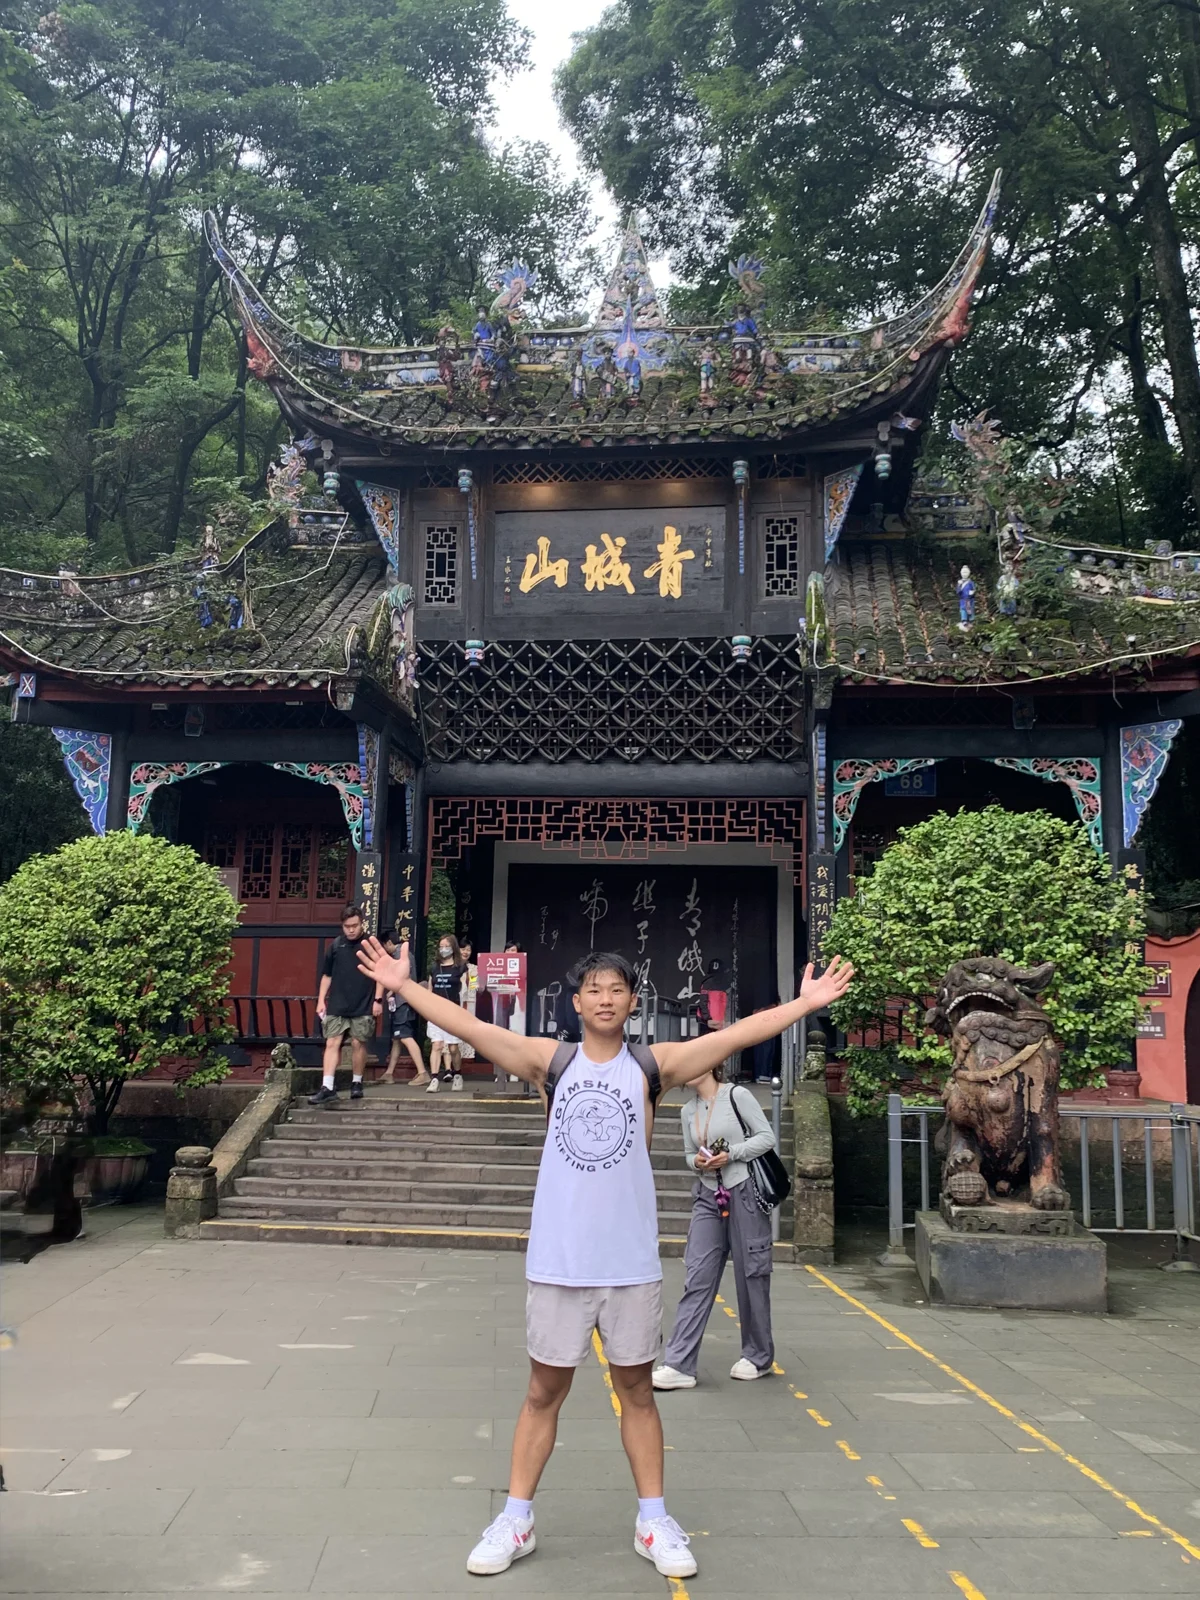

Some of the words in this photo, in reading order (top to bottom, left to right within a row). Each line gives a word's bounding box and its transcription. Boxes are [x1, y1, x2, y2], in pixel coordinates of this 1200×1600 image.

[519, 525, 695, 599] 青城山
[900, 774, 923, 789] 68
[486, 957, 504, 967] 入口
[555, 1079, 637, 1124] GYMSHARK
[555, 1135, 596, 1172] LIFTING
[603, 1139, 633, 1169] CLUB
